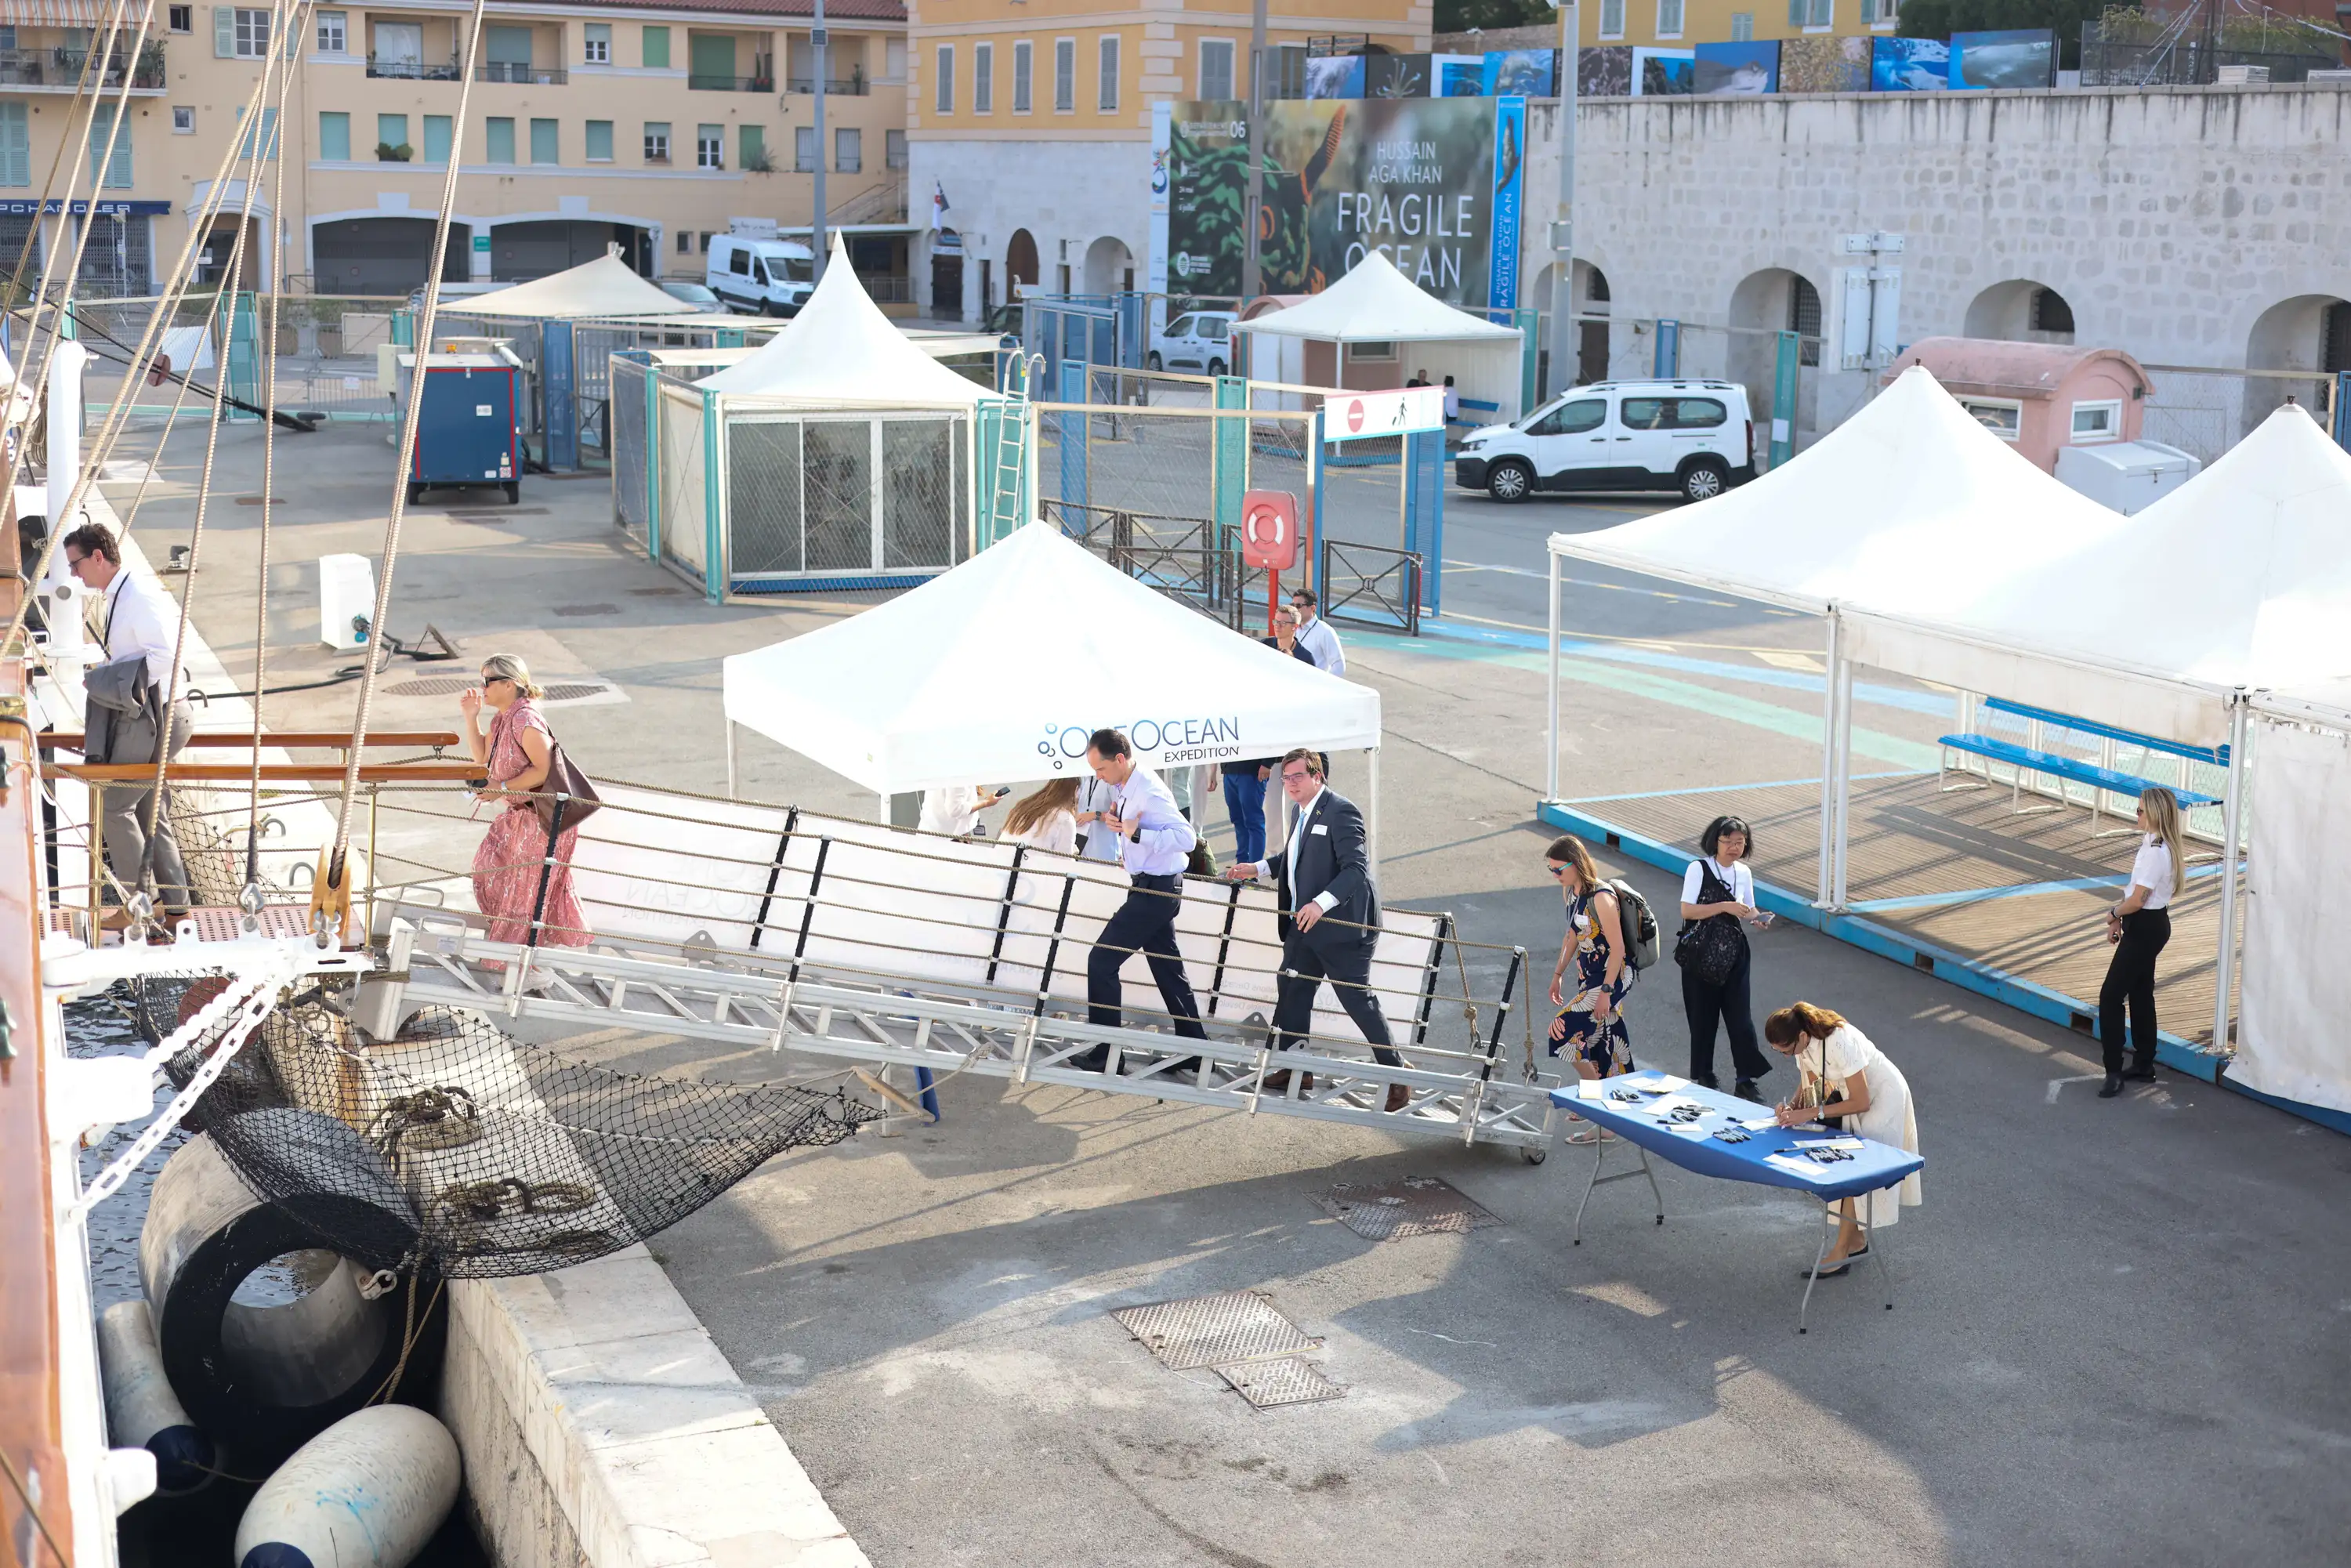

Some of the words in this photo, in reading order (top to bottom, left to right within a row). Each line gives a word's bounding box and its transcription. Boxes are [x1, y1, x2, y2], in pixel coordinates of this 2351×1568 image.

[1230, 121, 1246, 138] 06
[1376, 141, 1436, 160] HUSSAIN
[1369, 165, 1399, 183] AGA
[1402, 165, 1443, 185] KHAN
[1337, 192, 1474, 237] FRAGILE
[1502, 193, 1512, 248] OCEAN
[1499, 253, 1509, 309] RAGILE
[1165, 746, 1240, 762] EXPEDITION
